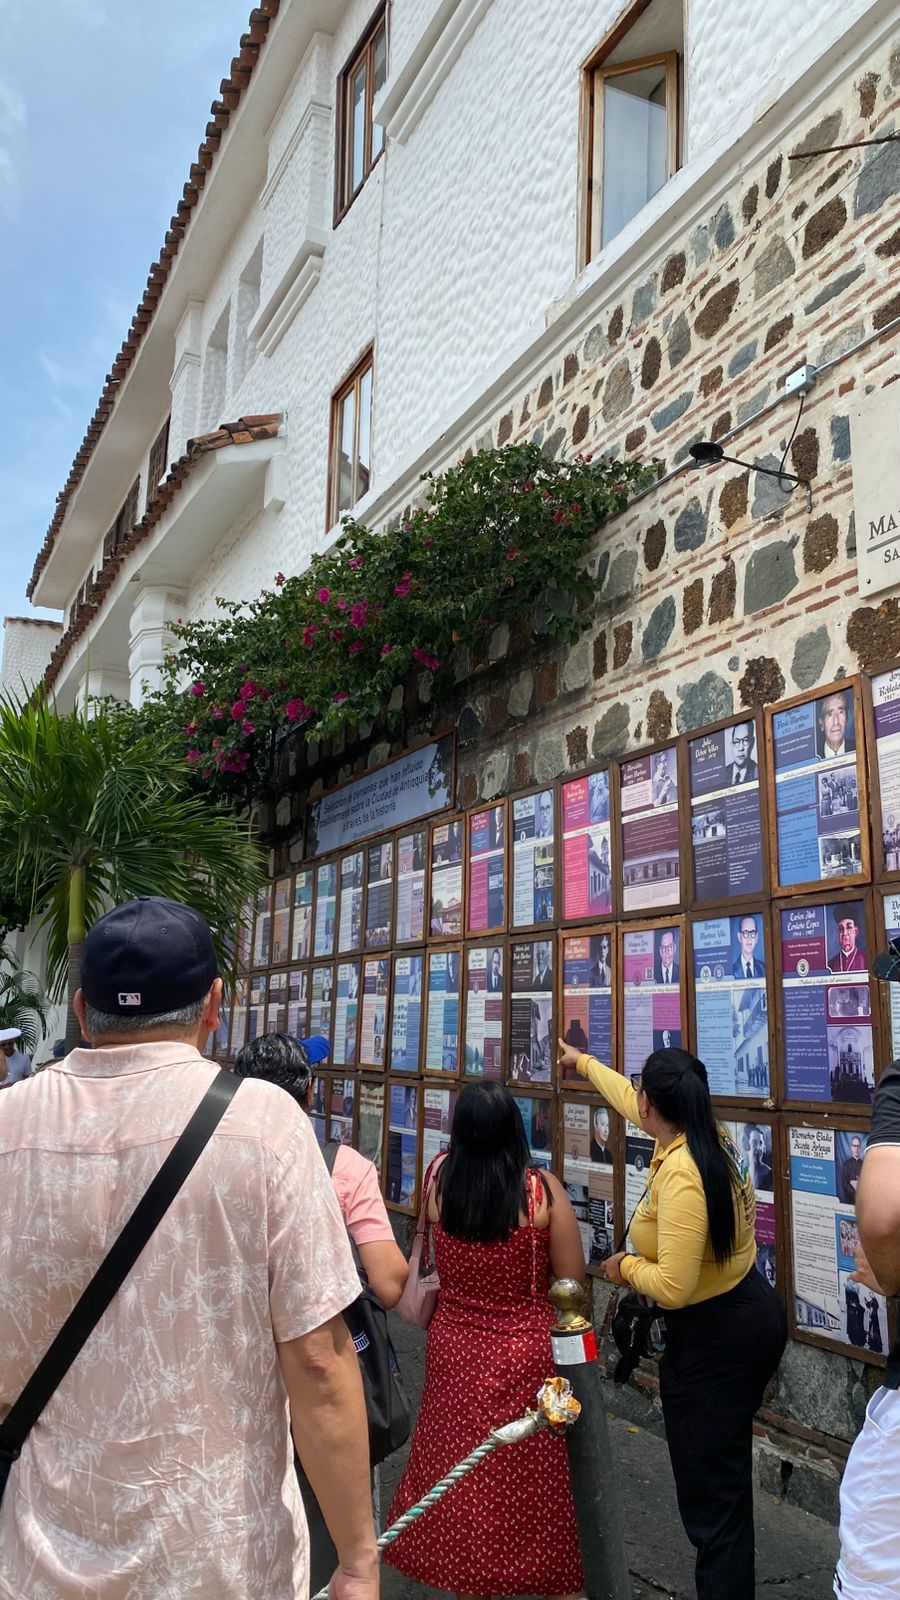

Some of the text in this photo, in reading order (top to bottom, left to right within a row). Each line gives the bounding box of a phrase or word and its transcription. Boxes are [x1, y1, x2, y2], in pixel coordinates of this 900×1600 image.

[868, 510, 900, 540] MA
[371, 787, 392, 805] Ciudad
[400, 771, 429, 793] Antioquia
